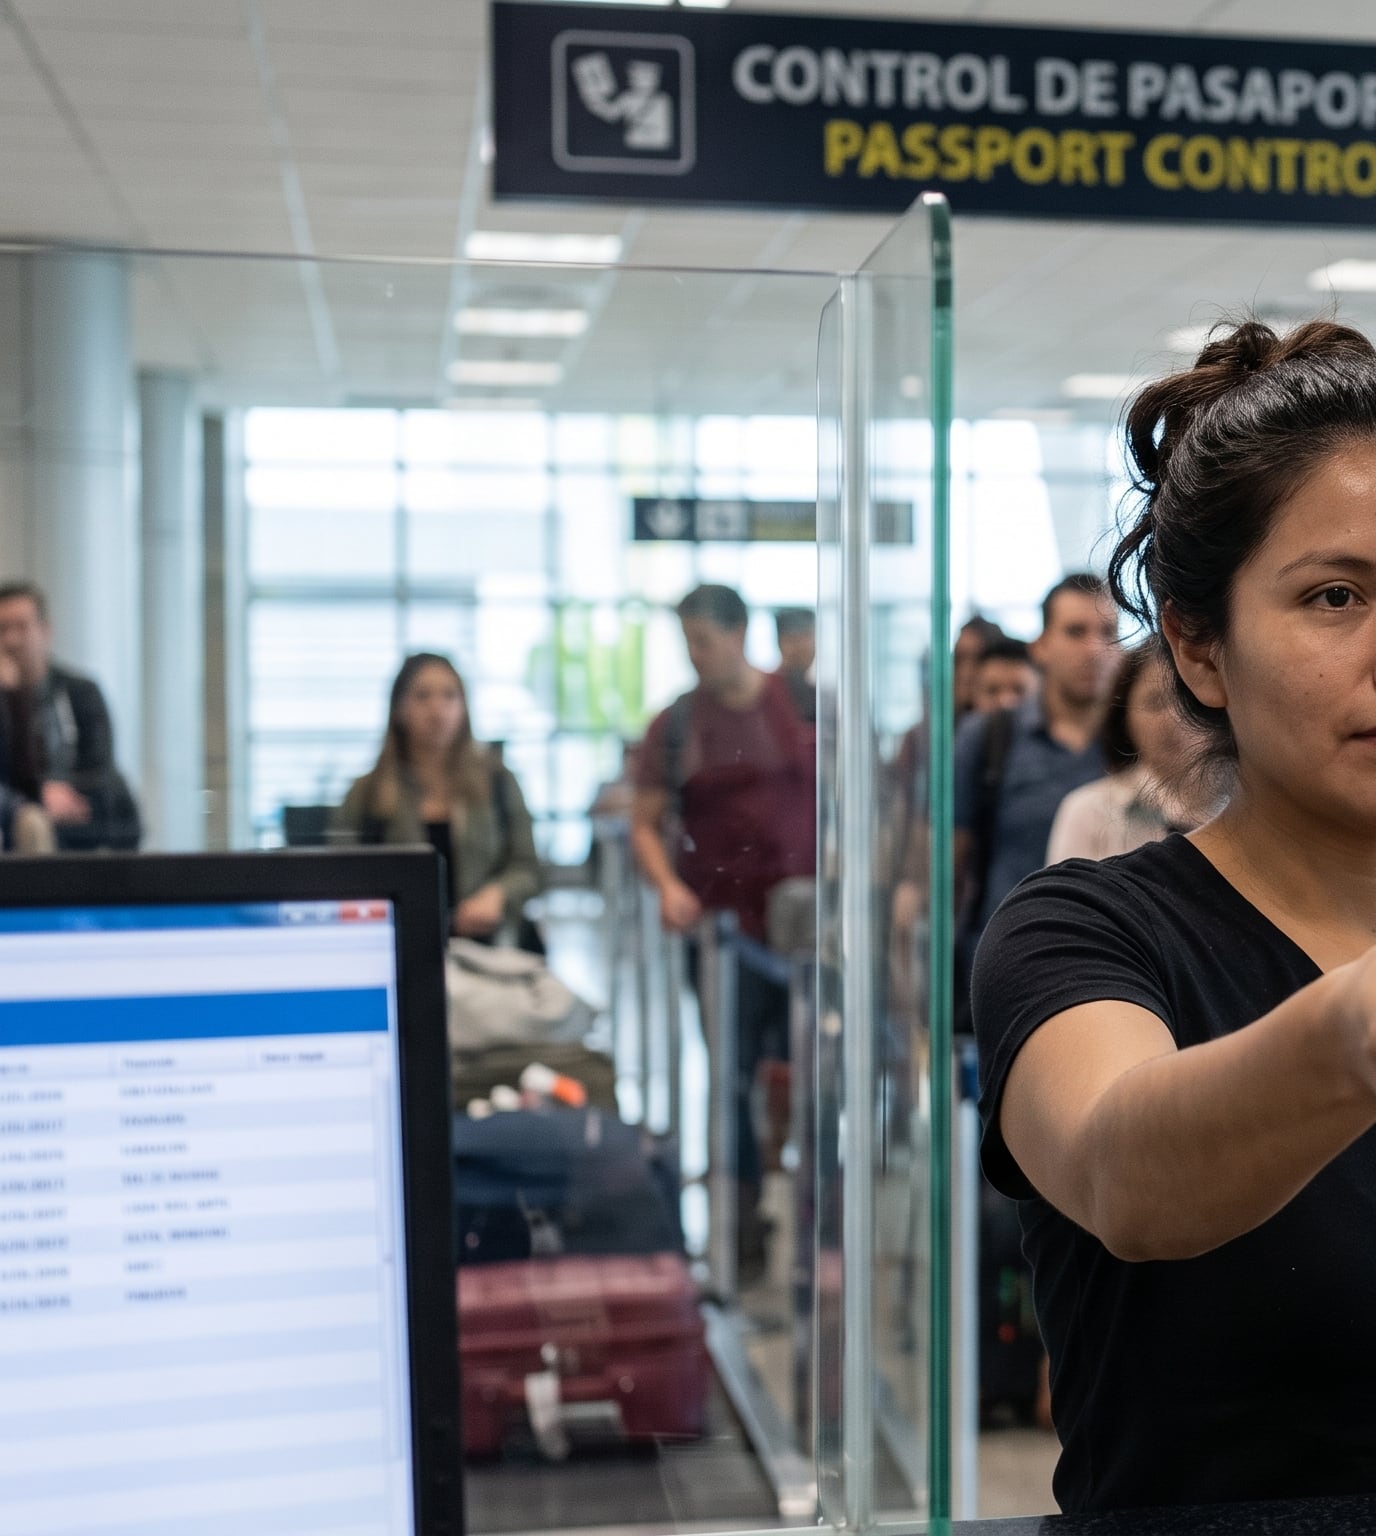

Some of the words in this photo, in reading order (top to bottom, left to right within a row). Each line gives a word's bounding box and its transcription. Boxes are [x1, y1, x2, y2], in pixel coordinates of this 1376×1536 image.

[733, 45, 1022, 112] CONTROL
[1036, 59, 1115, 116] DE
[825, 122, 1131, 187] PASSPORT
